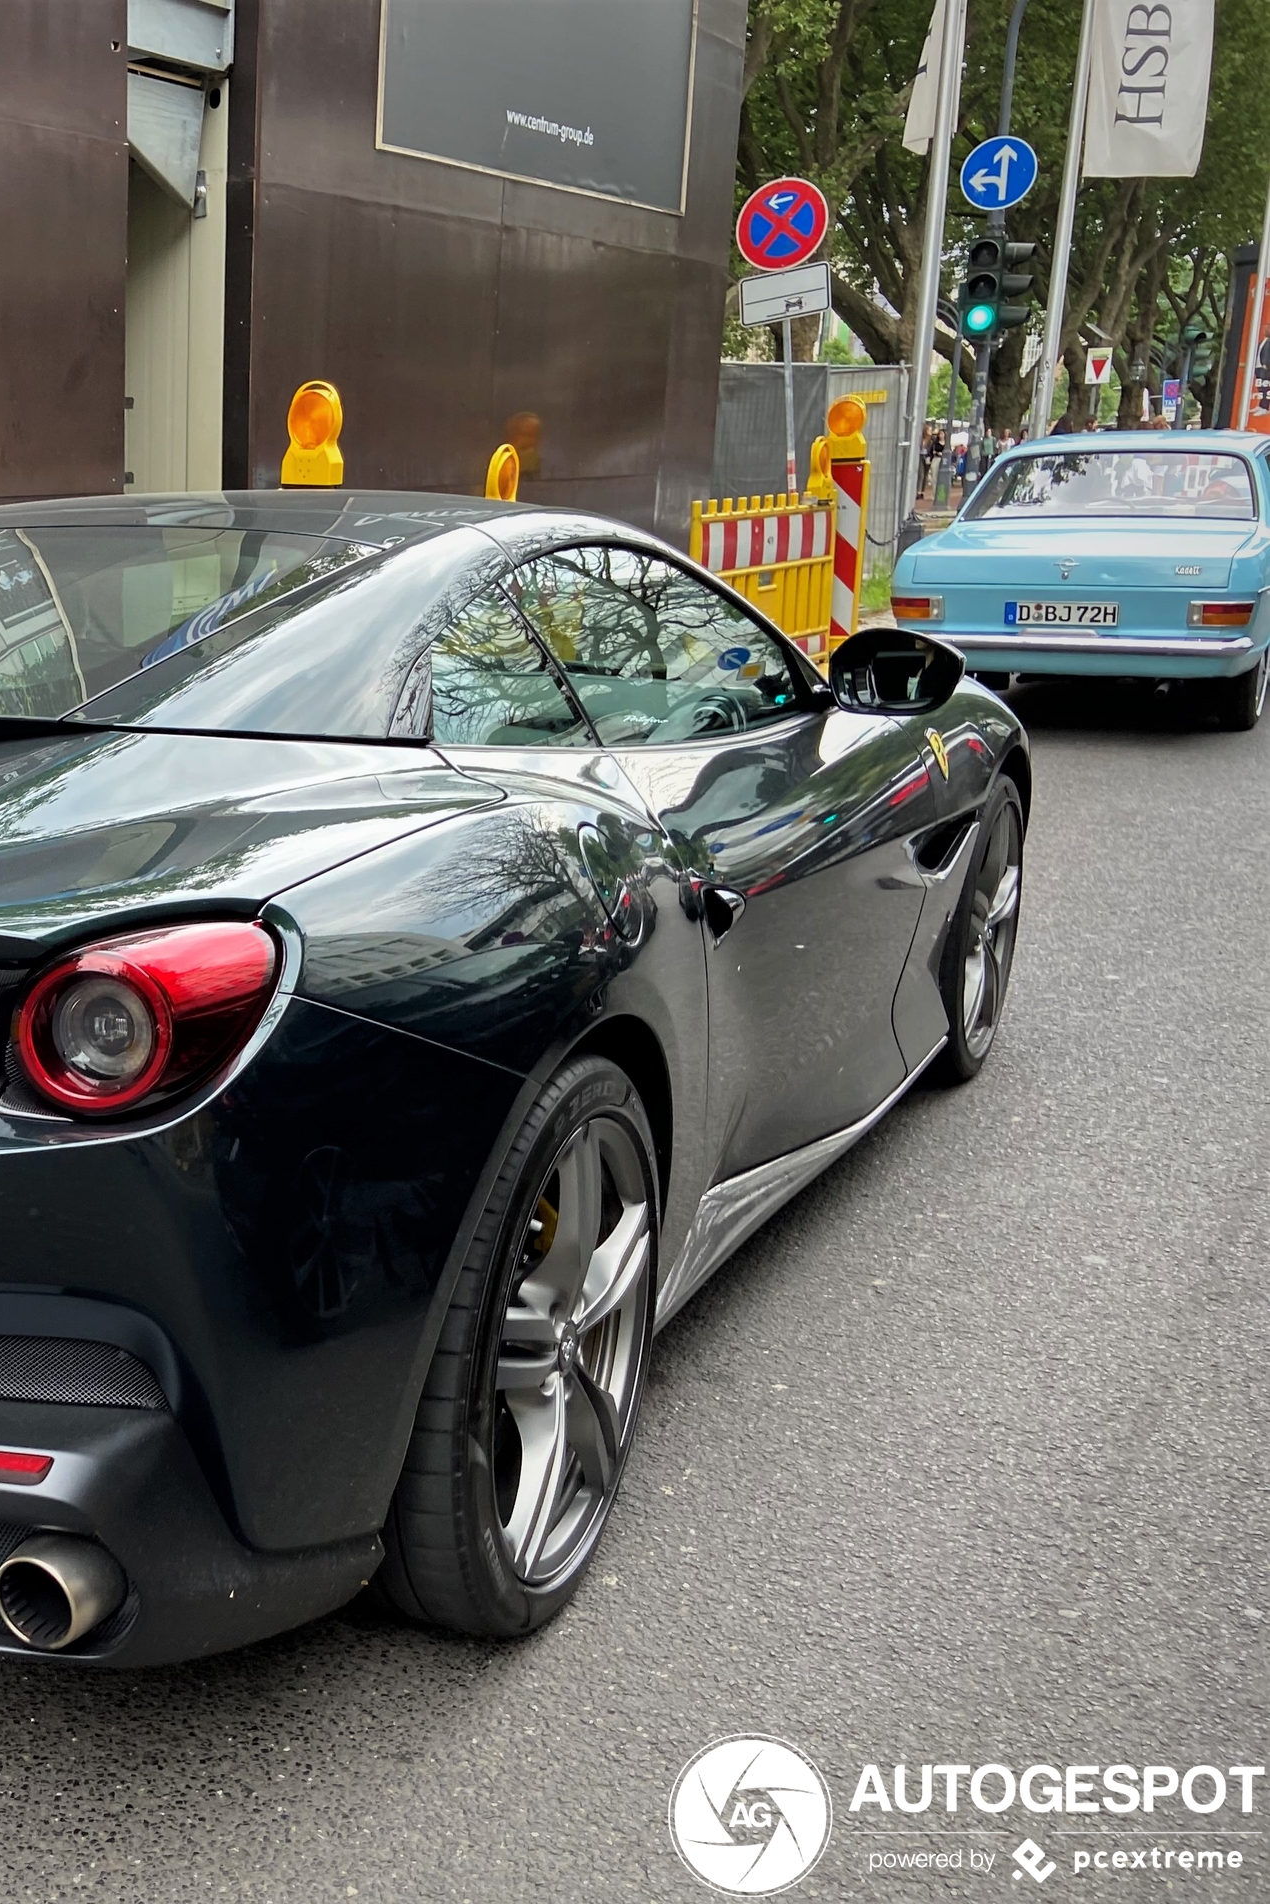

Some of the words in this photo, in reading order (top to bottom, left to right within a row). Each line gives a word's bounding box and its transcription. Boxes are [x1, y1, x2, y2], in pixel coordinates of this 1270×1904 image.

[1114, 4, 1172, 130] HSB
[506, 109, 594, 147] www.centrum-group.de
[1174, 564, 1202, 576] Kadett
[1018, 605, 1030, 621] D
[1044, 606, 1071, 622] BJ
[1076, 606, 1117, 623] 72H
